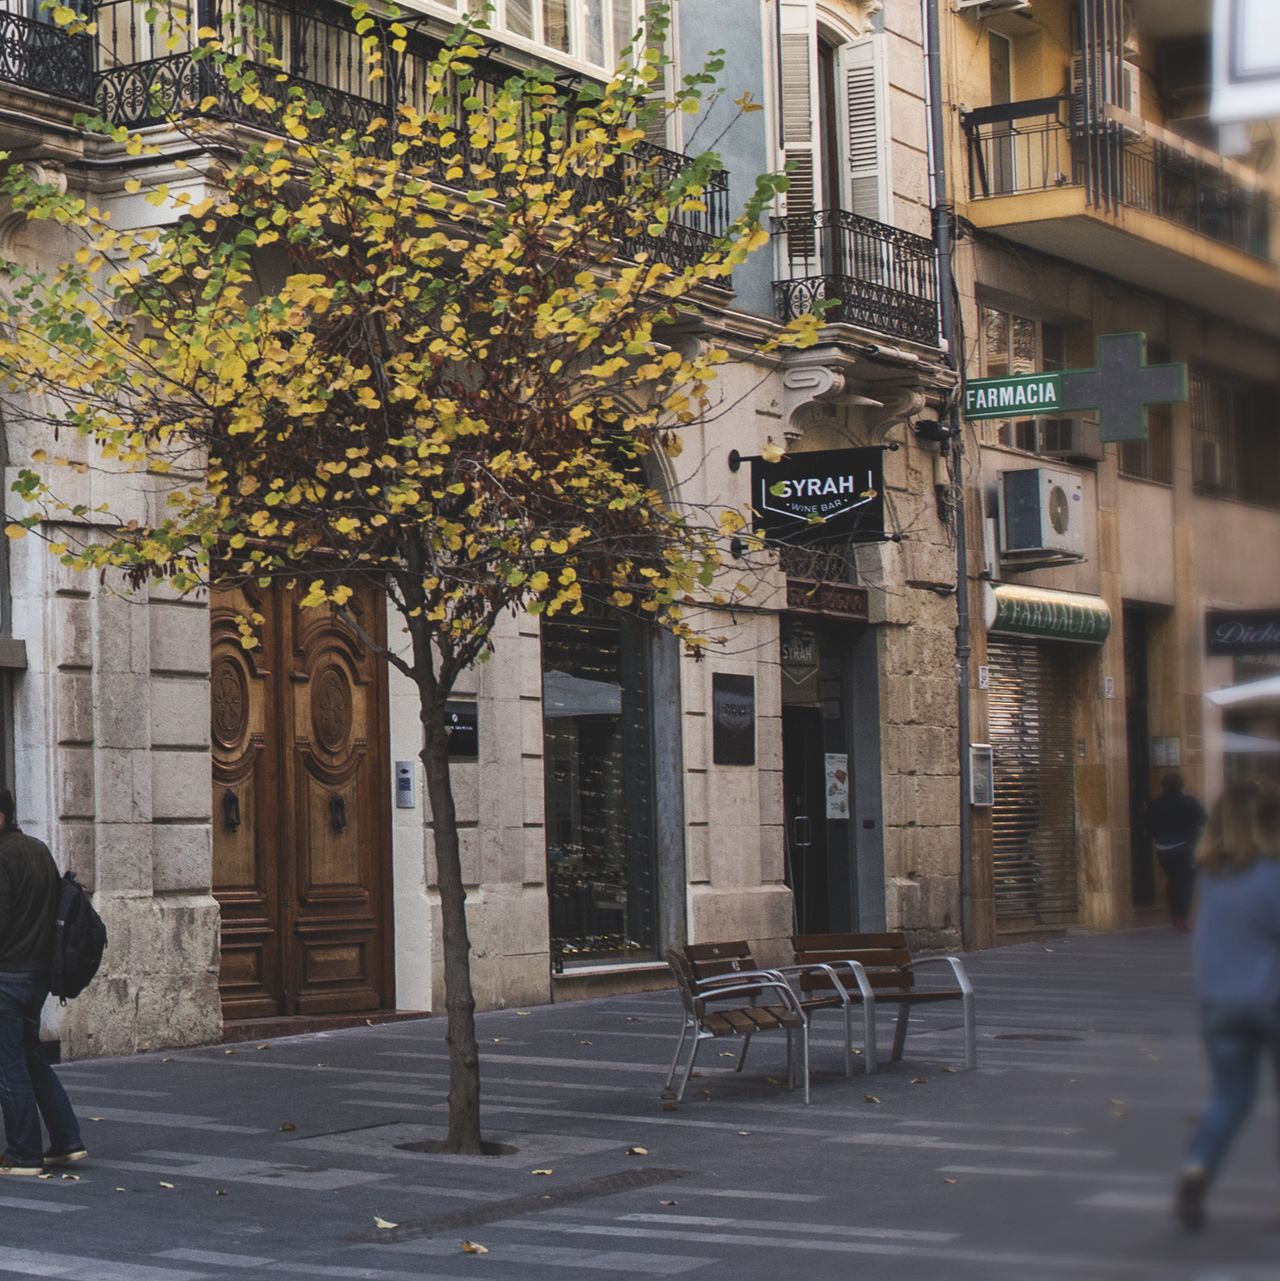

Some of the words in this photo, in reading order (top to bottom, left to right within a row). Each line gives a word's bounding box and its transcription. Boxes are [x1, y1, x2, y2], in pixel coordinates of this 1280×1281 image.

[966, 382, 1057, 410] FARMACIA
[779, 475, 854, 498] SYRAH
[791, 503, 818, 513] WINE
[820, 499, 842, 512] BAR
[1011, 600, 1096, 634] FARMACIA
